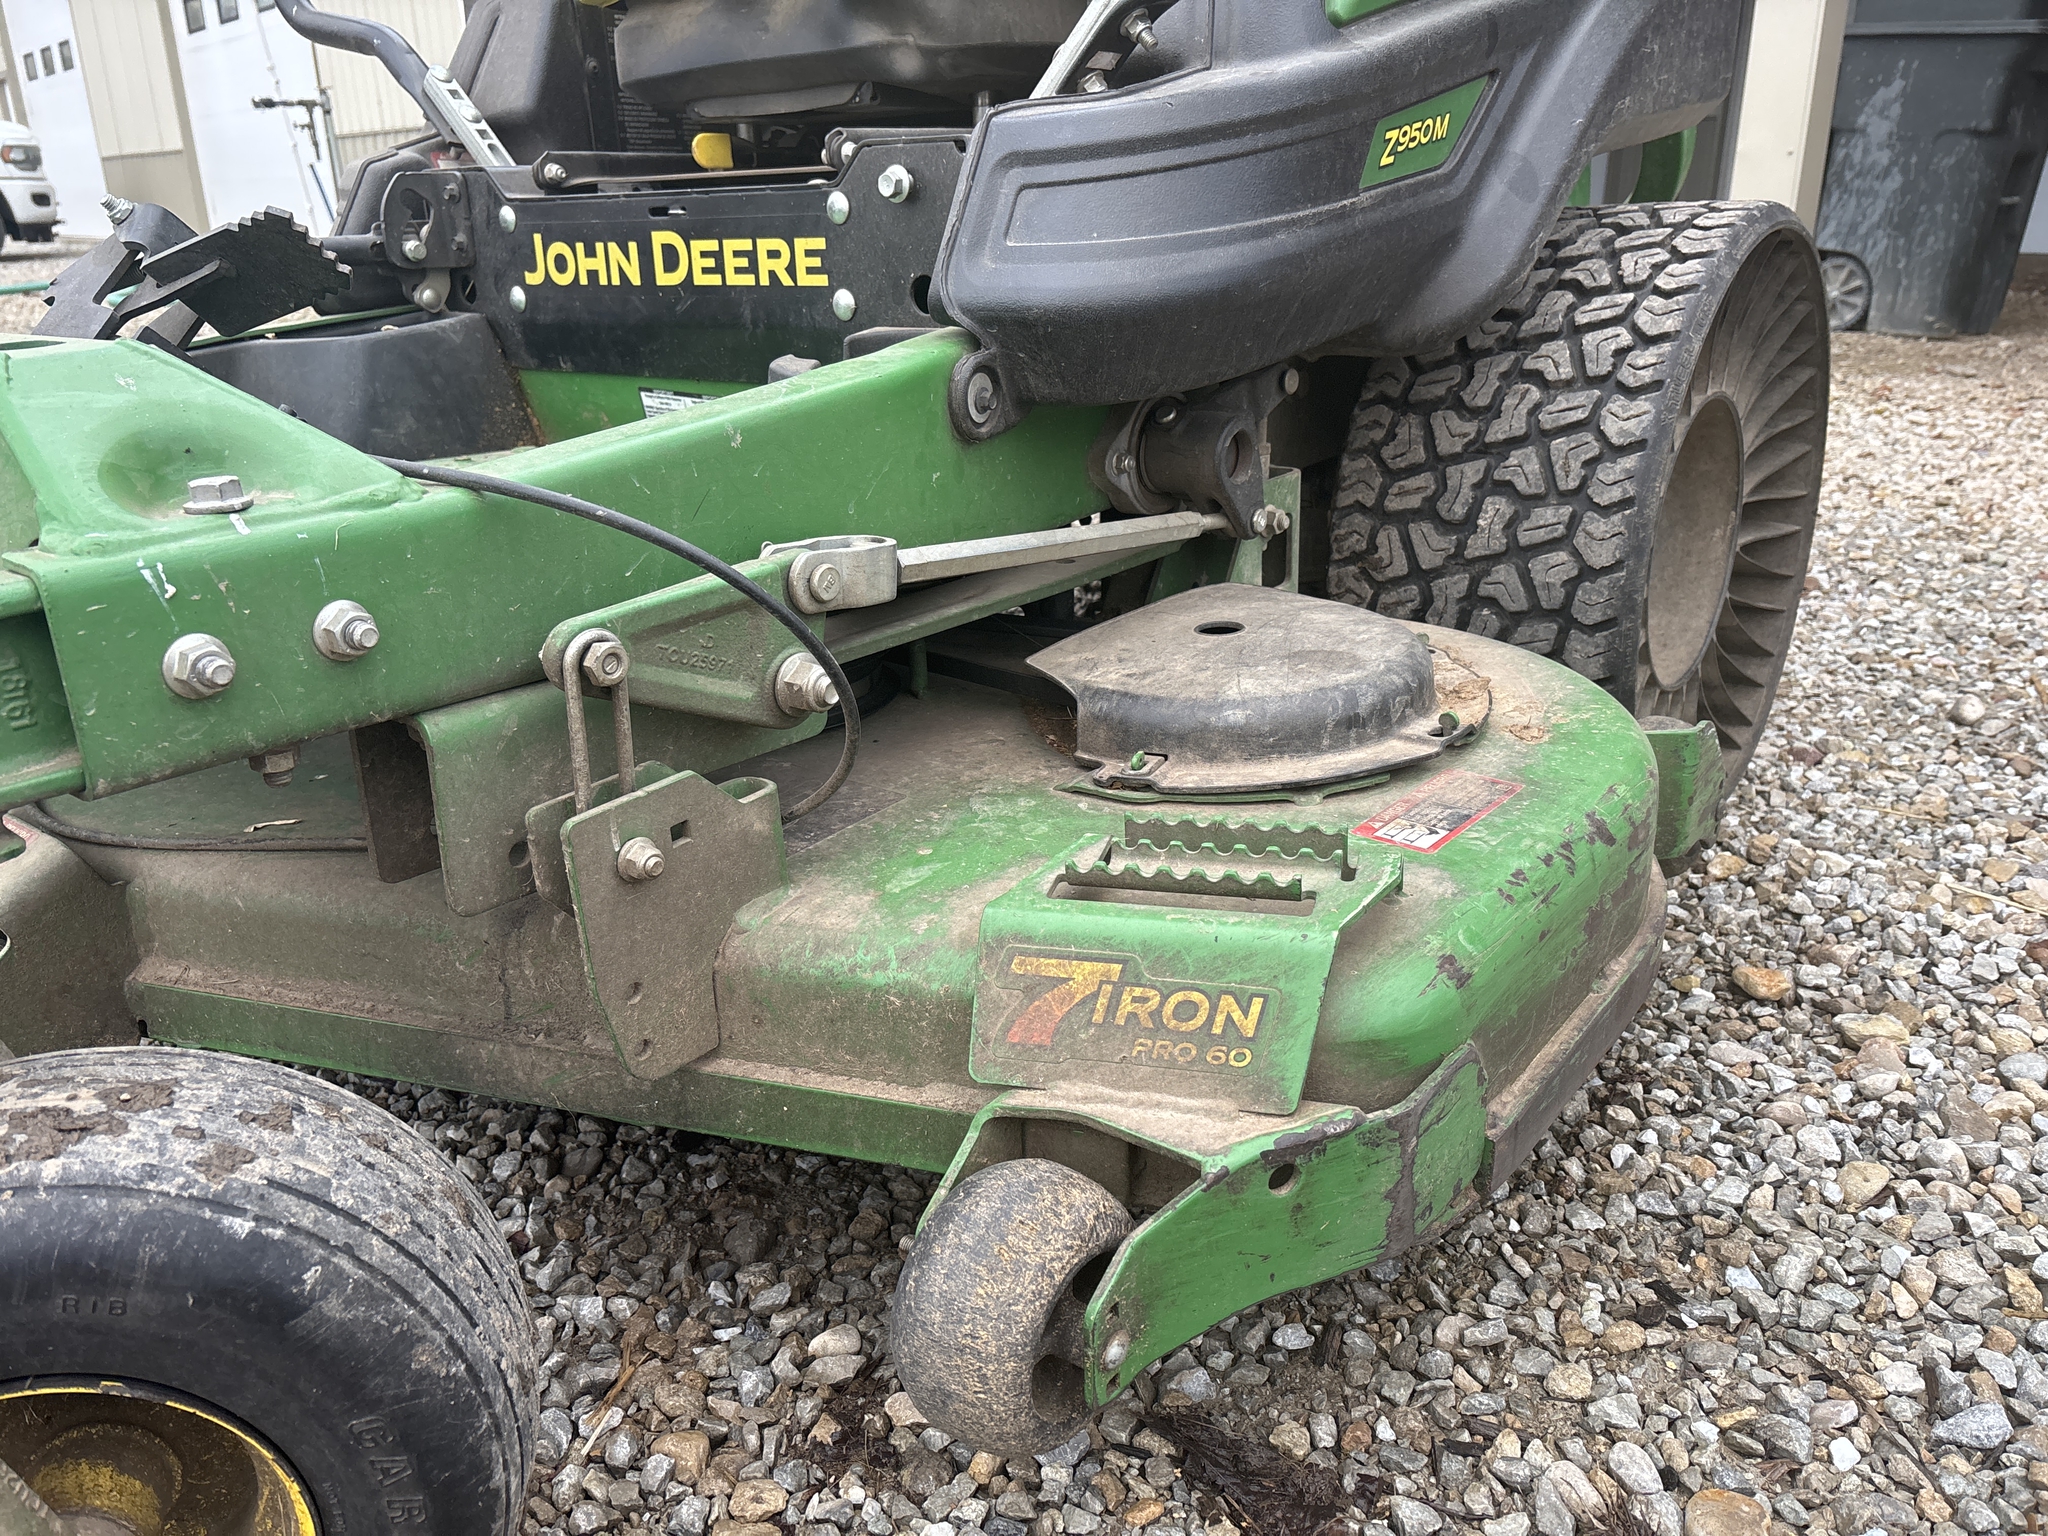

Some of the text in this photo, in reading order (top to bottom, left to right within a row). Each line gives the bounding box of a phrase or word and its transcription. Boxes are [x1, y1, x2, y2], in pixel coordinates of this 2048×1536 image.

[1379, 112, 1451, 168] Z950M
[524, 231, 829, 286] JOHN DEERE
[1006, 955, 1264, 1046] 7 IRON
[1132, 1038, 1253, 1068] PRO 60
[61, 1294, 128, 1316] RIB
